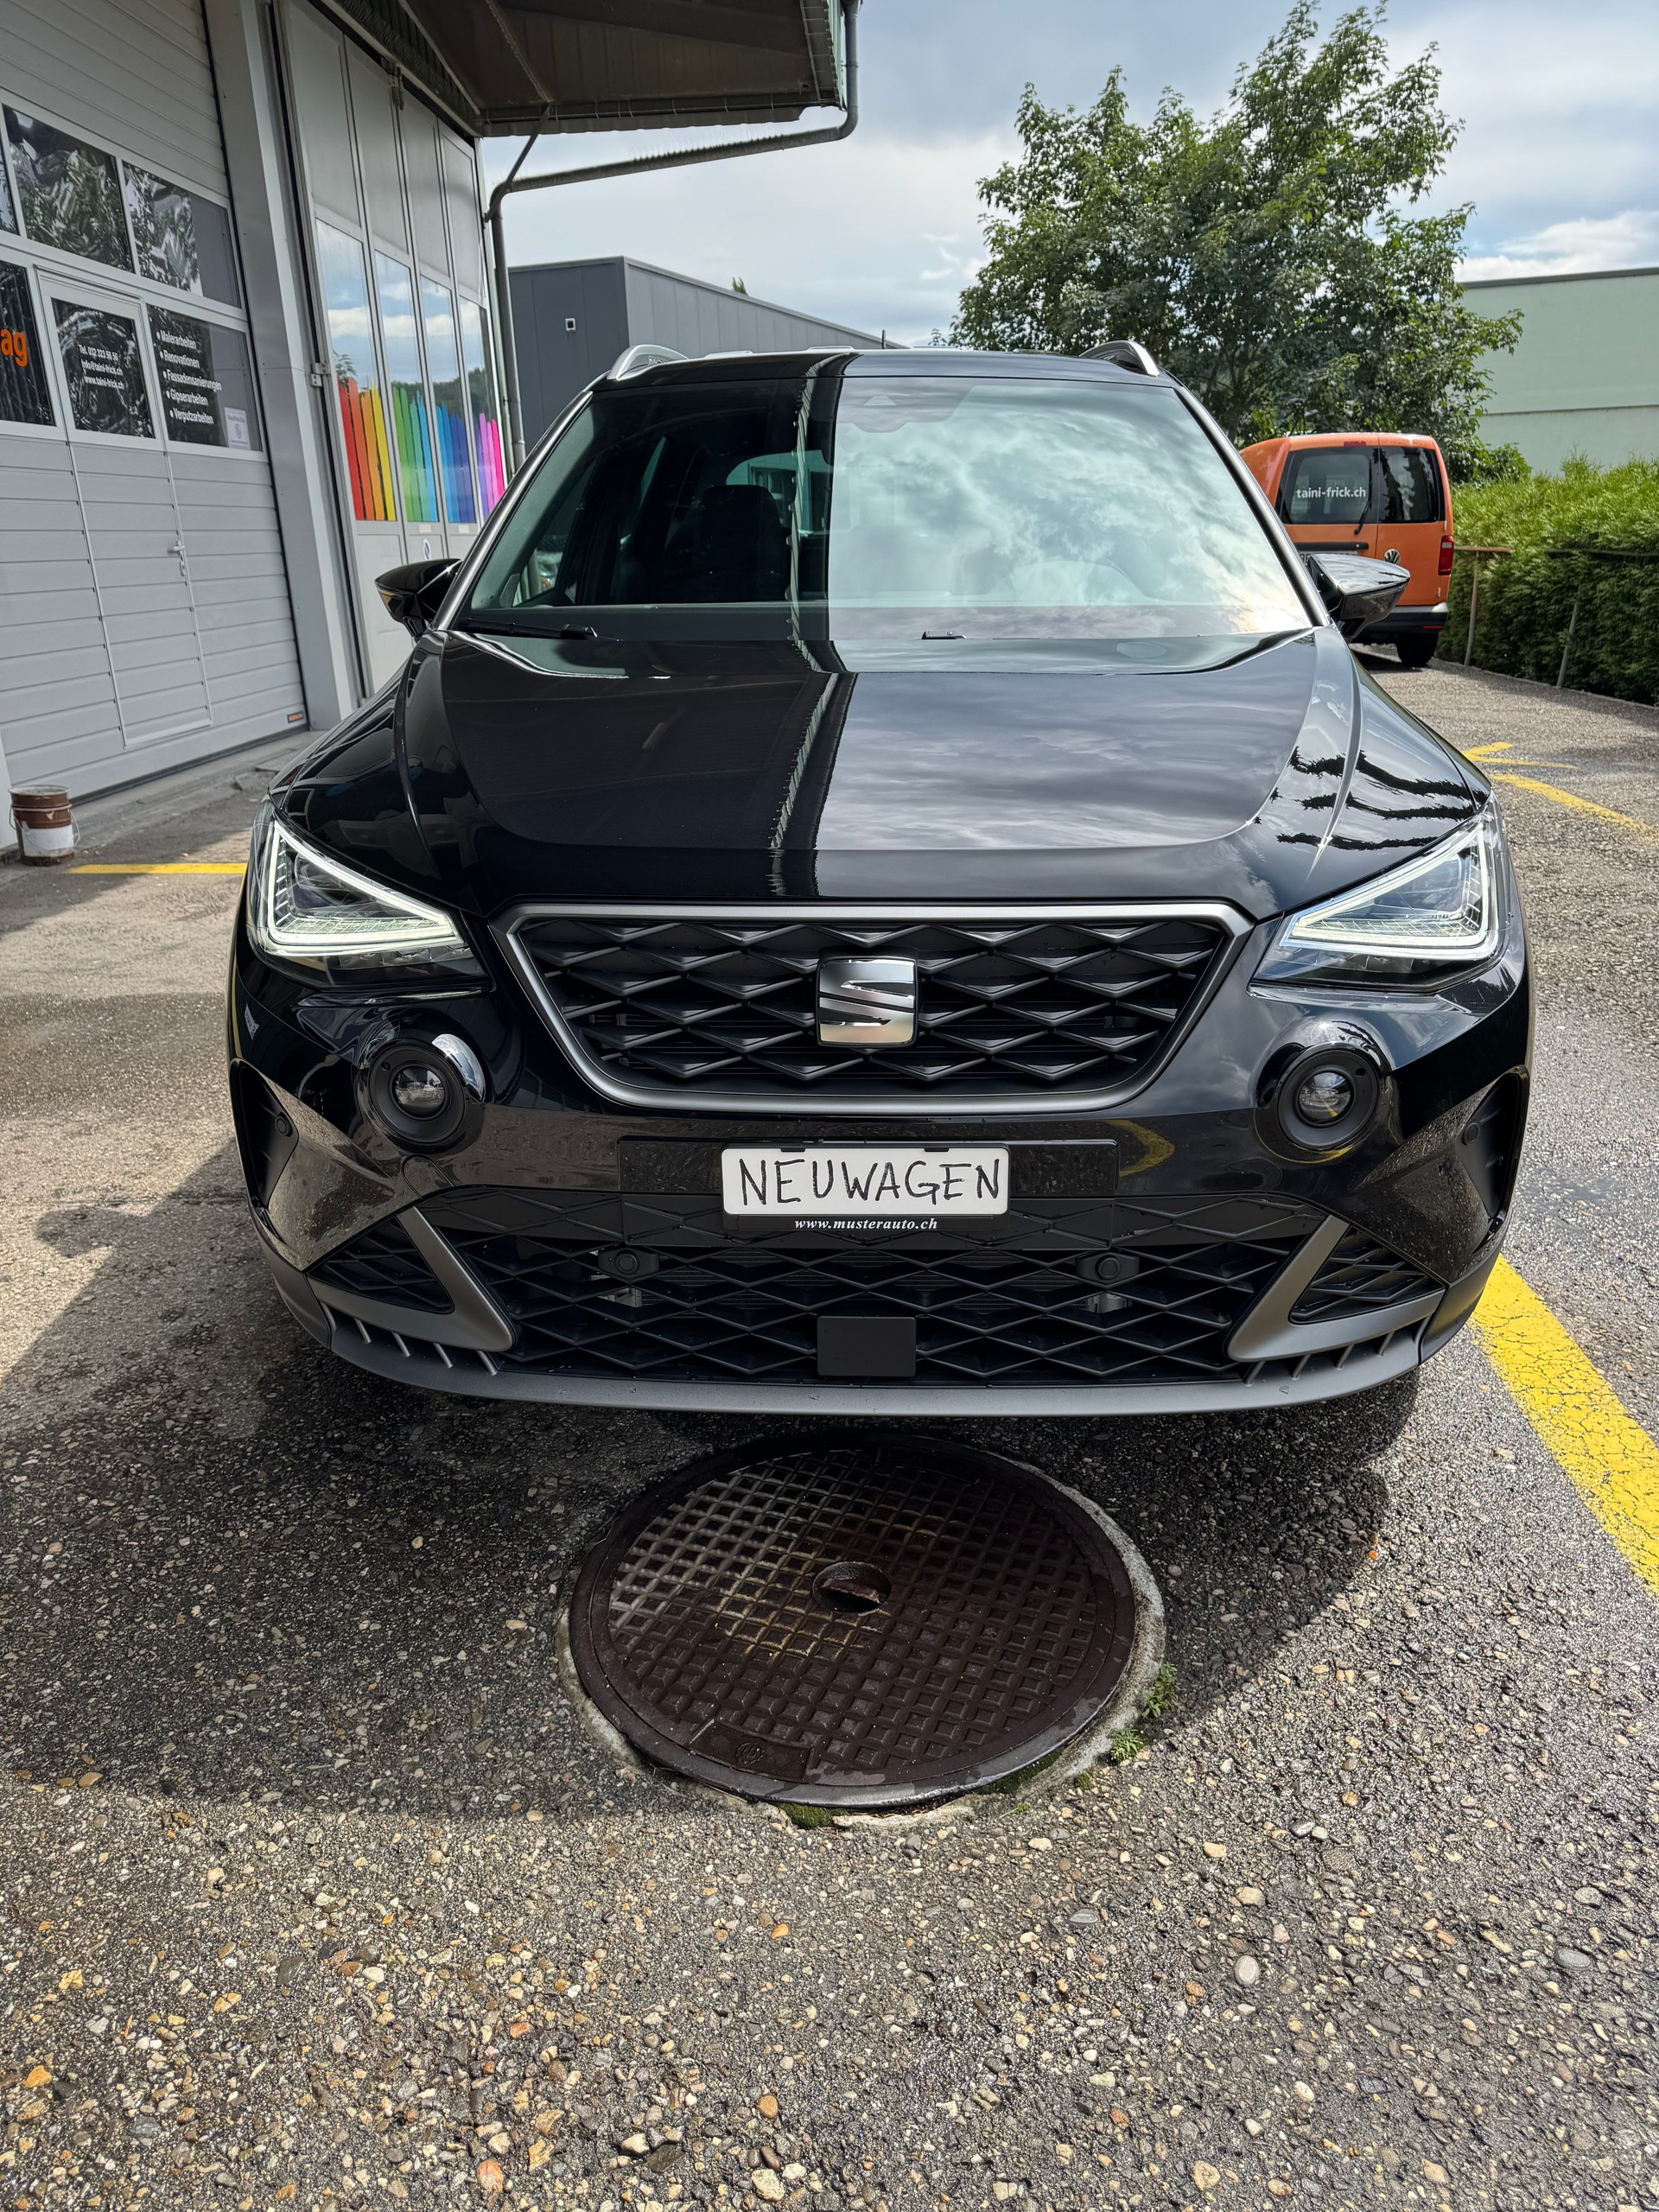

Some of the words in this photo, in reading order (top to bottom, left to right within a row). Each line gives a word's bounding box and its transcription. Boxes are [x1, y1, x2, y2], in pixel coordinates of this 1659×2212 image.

[161, 330, 197, 350] Malerarbeiten
[163, 349, 200, 368] Renovationen
[167, 369, 222, 392] Fassadensanierungen
[170, 388, 209, 406] Gipserarbeiten
[173, 407, 214, 424] Verputzarbeiten
[1296, 486, 1366, 499] taini-frick.ch
[739, 1158, 1000, 1205] NEUWAGEN
[794, 1217, 938, 1230] www.musterauto.ch
